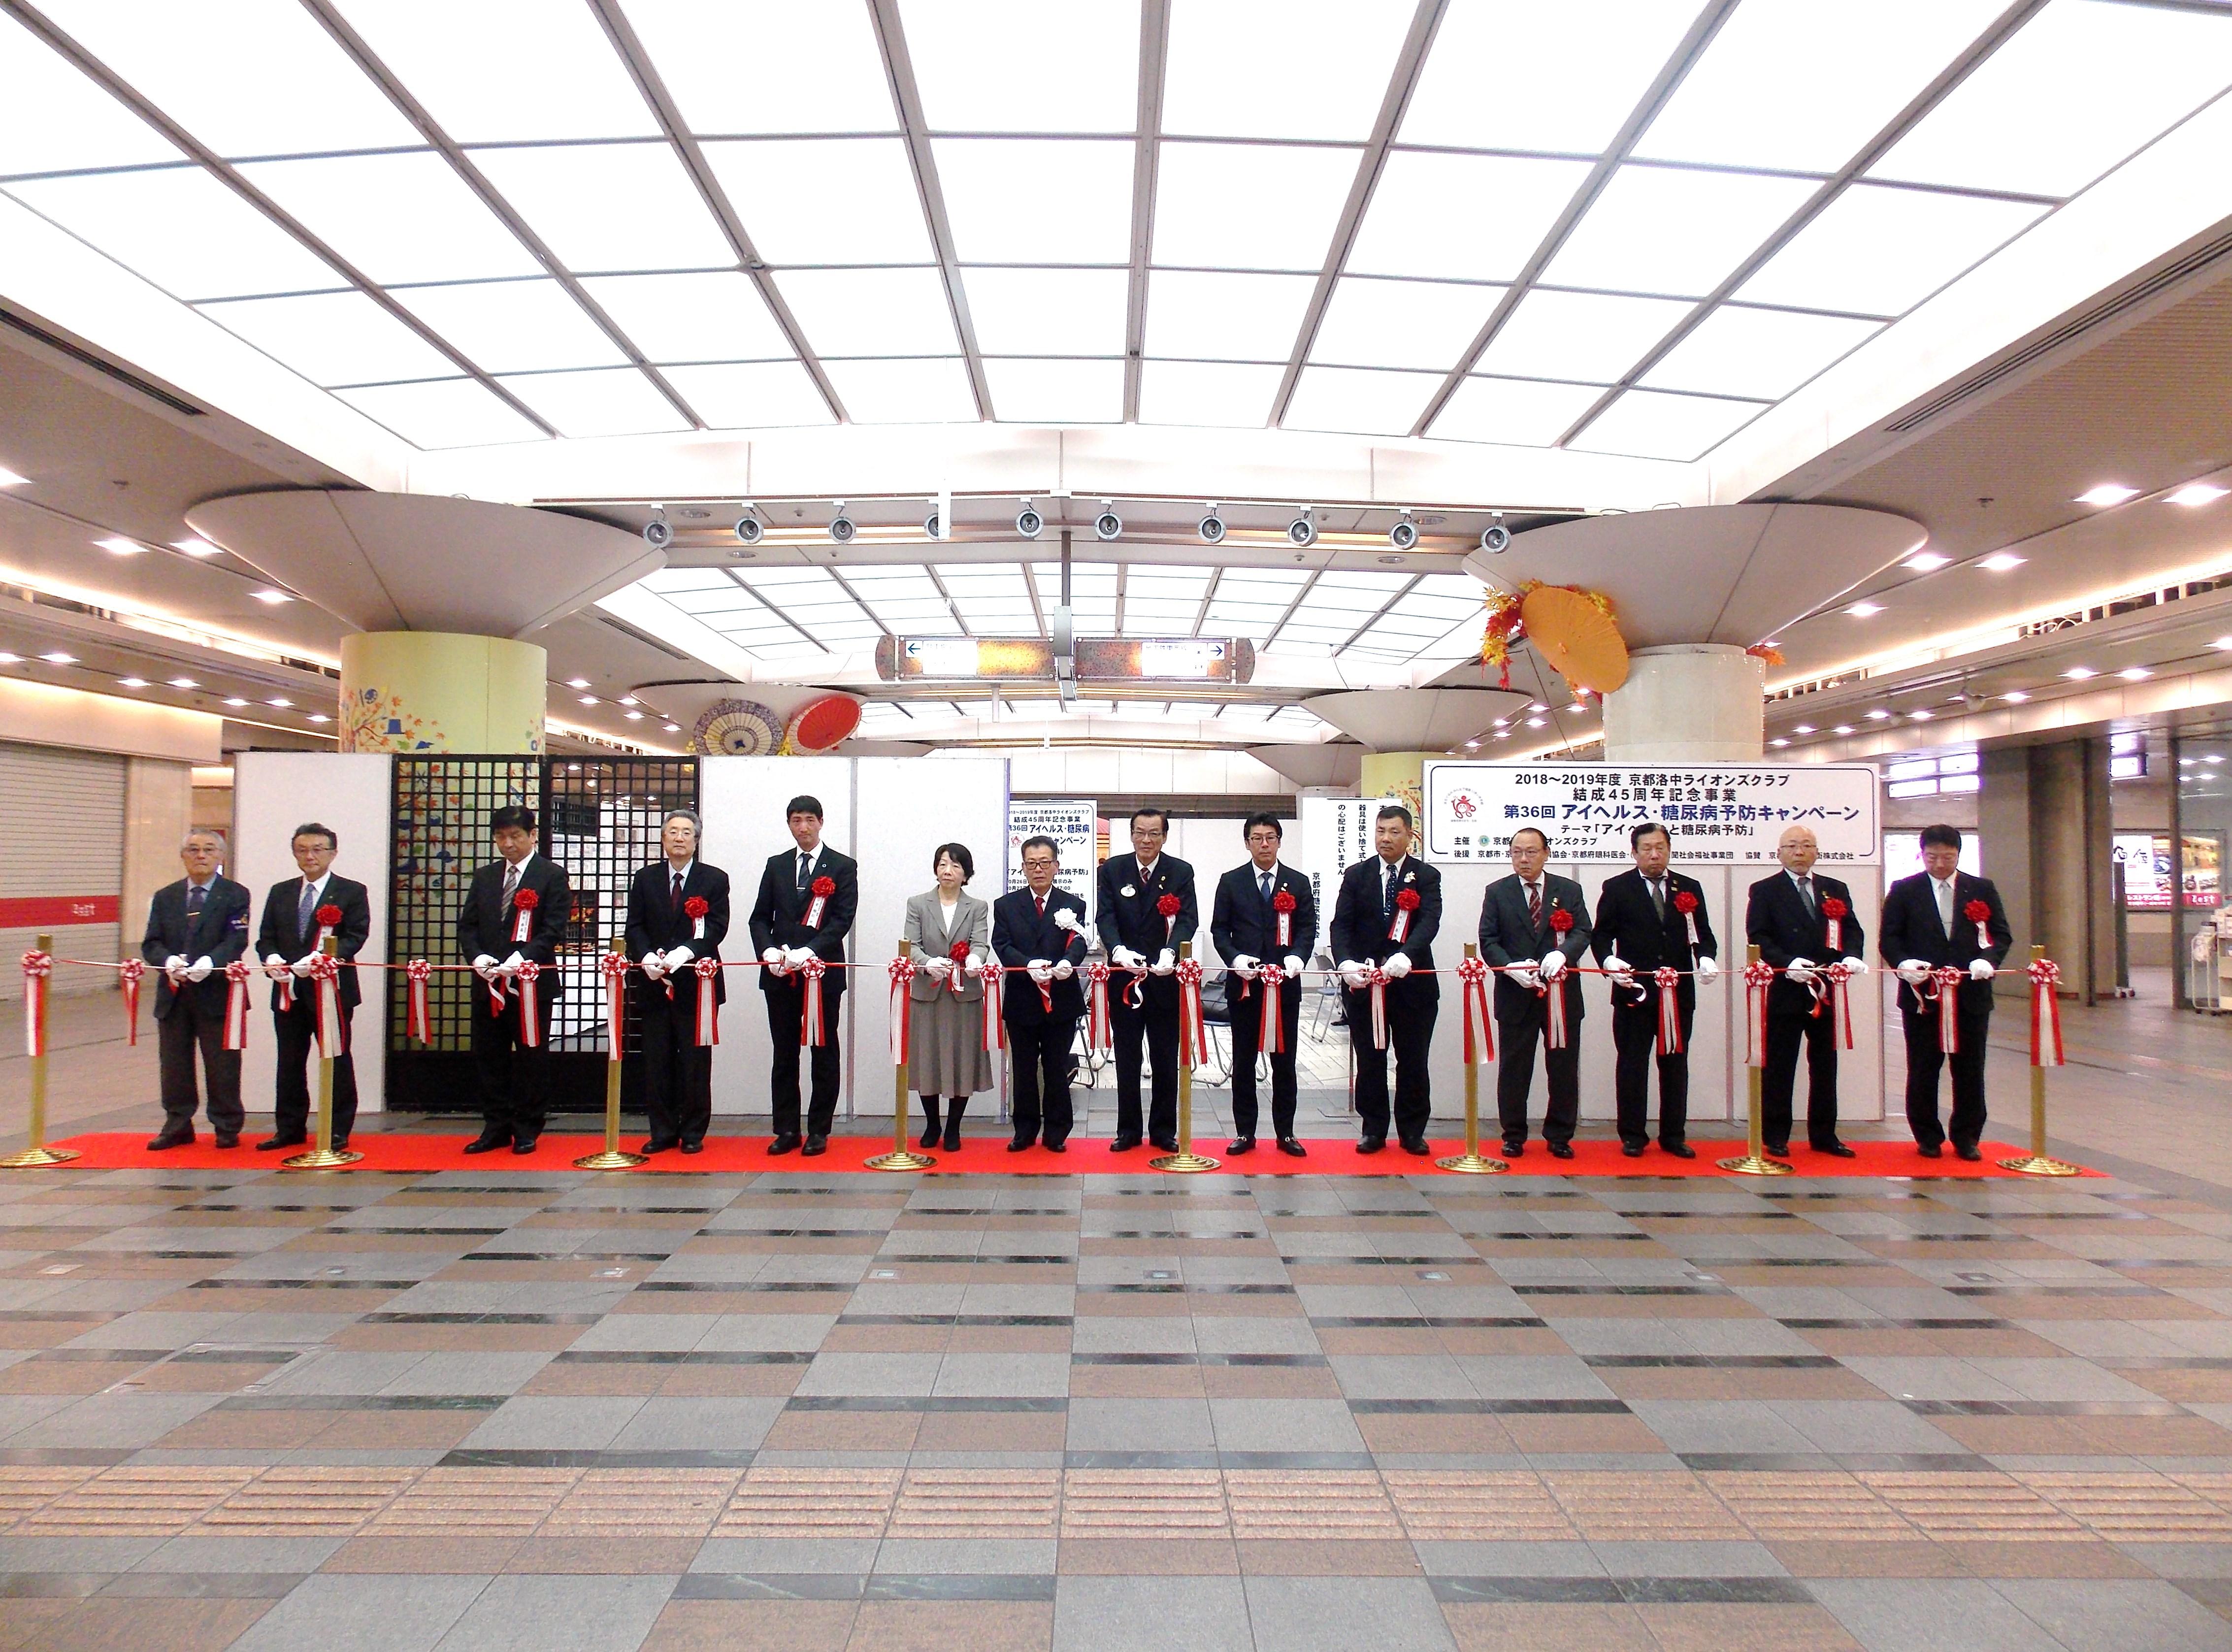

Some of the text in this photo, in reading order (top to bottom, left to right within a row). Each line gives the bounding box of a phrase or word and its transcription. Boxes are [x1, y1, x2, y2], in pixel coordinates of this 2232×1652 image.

[1629, 773, 1790, 787] 京都洛中ライオンズクラブ
[1573, 788, 1736, 802] 結成45周年記念事業
[1504, 804, 1859, 821] 第36回 アイヘルス・糖尿病予防キャンペーン
[1029, 824, 1089, 833] アイヘルス・糖尿病
[1338, 804, 1346, 875] の心配はございません
[1493, 837, 1598, 845] 京都オンズクラブ
